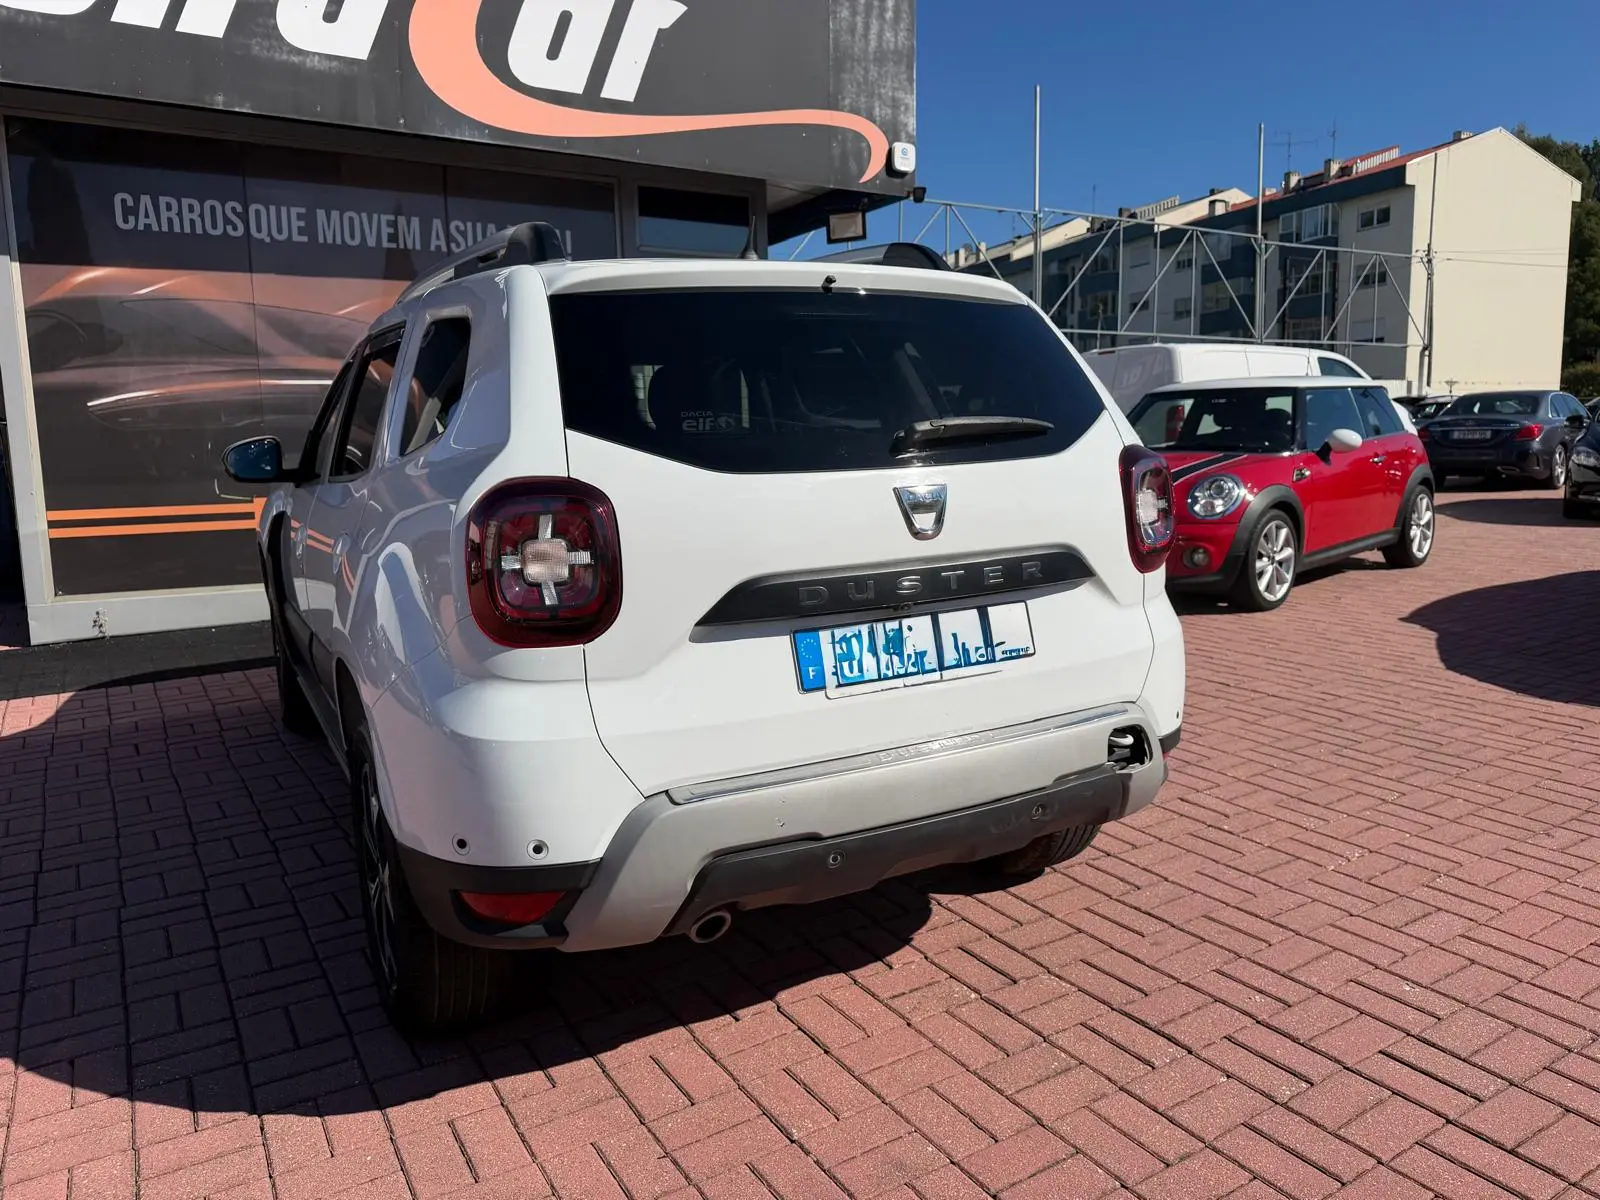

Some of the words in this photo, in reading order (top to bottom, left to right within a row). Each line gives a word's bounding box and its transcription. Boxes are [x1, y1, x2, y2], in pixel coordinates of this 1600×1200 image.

[113, 192, 245, 237] CARROS
[248, 203, 308, 243] QUE
[316, 208, 421, 251] MOVEM
[429, 218, 448, 252] A
[797, 560, 1043, 607] DUSTER
[808, 667, 817, 680] F
